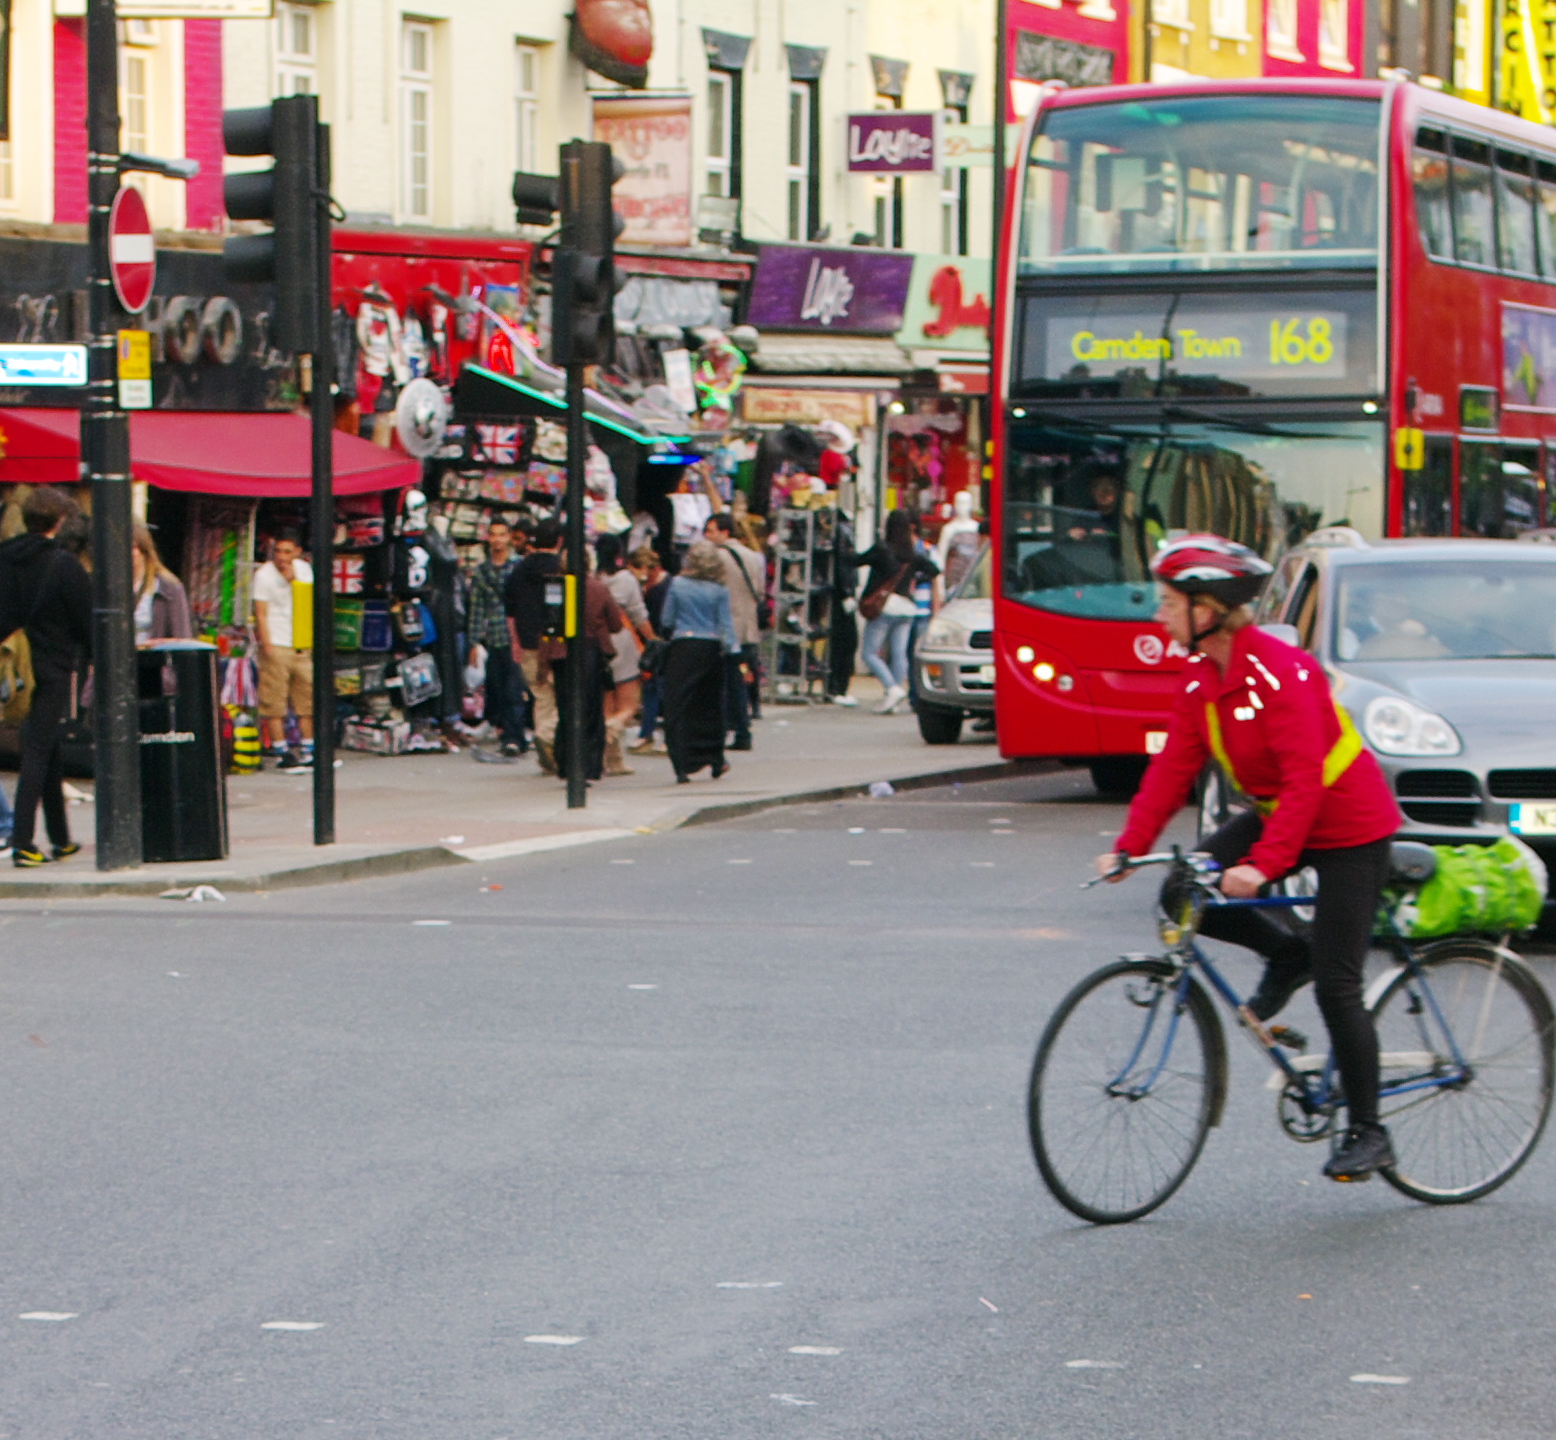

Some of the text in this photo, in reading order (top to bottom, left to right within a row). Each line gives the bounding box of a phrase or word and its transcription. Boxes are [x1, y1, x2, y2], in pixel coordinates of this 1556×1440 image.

[1071, 317, 1334, 365] Camden Town 168
